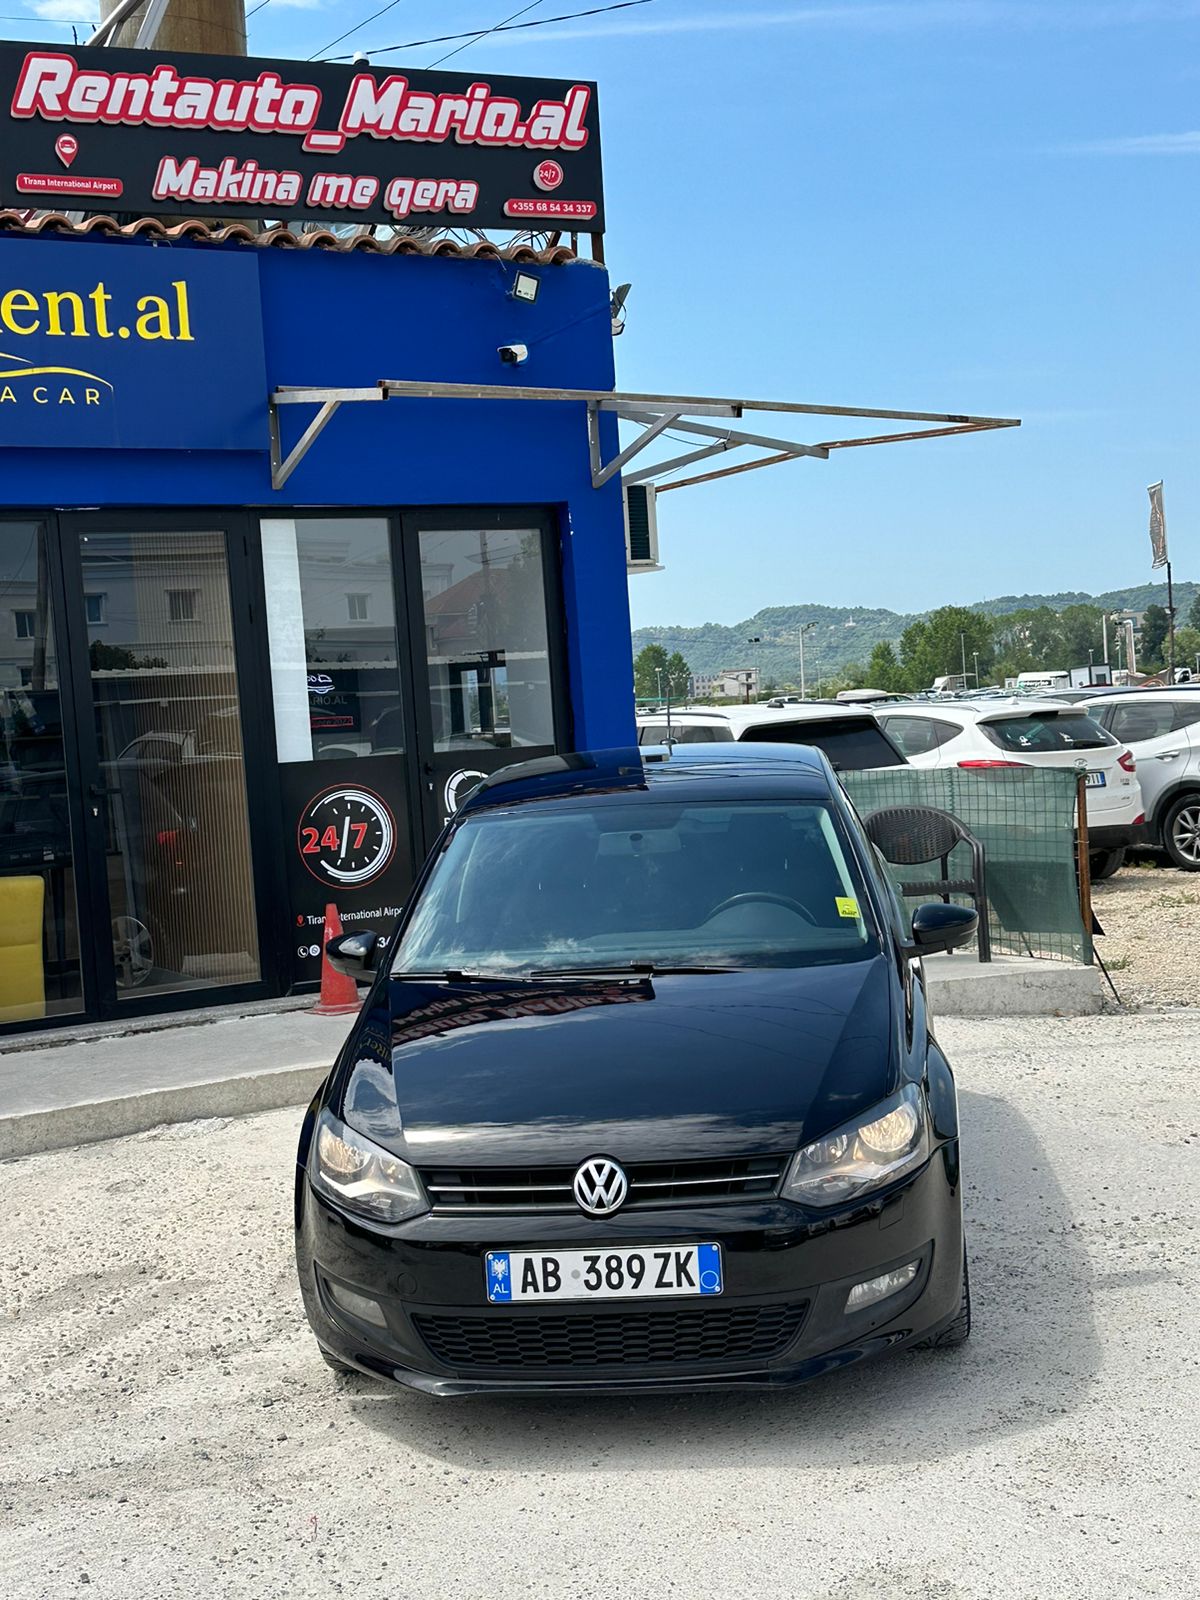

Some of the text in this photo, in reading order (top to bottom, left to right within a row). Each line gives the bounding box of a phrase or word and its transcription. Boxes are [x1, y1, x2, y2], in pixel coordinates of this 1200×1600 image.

[11, 53, 590, 152] Rentauto_Mario.al
[154, 156, 302, 204] Makina
[308, 173, 378, 207] me
[539, 169, 556, 180] 24/7
[23, 177, 117, 191] Tirana International Airport
[513, 203, 592, 213] +355 68 54 34 337
[0, 280, 195, 341] ent.al
[33, 387, 100, 405] CAR
[302, 816, 368, 858] 24/7
[307, 914, 327, 925] Tiran
[339, 907, 383, 921] ternational
[521, 1251, 696, 1293] AB 389 ZK
[493, 1283, 509, 1294] AL
